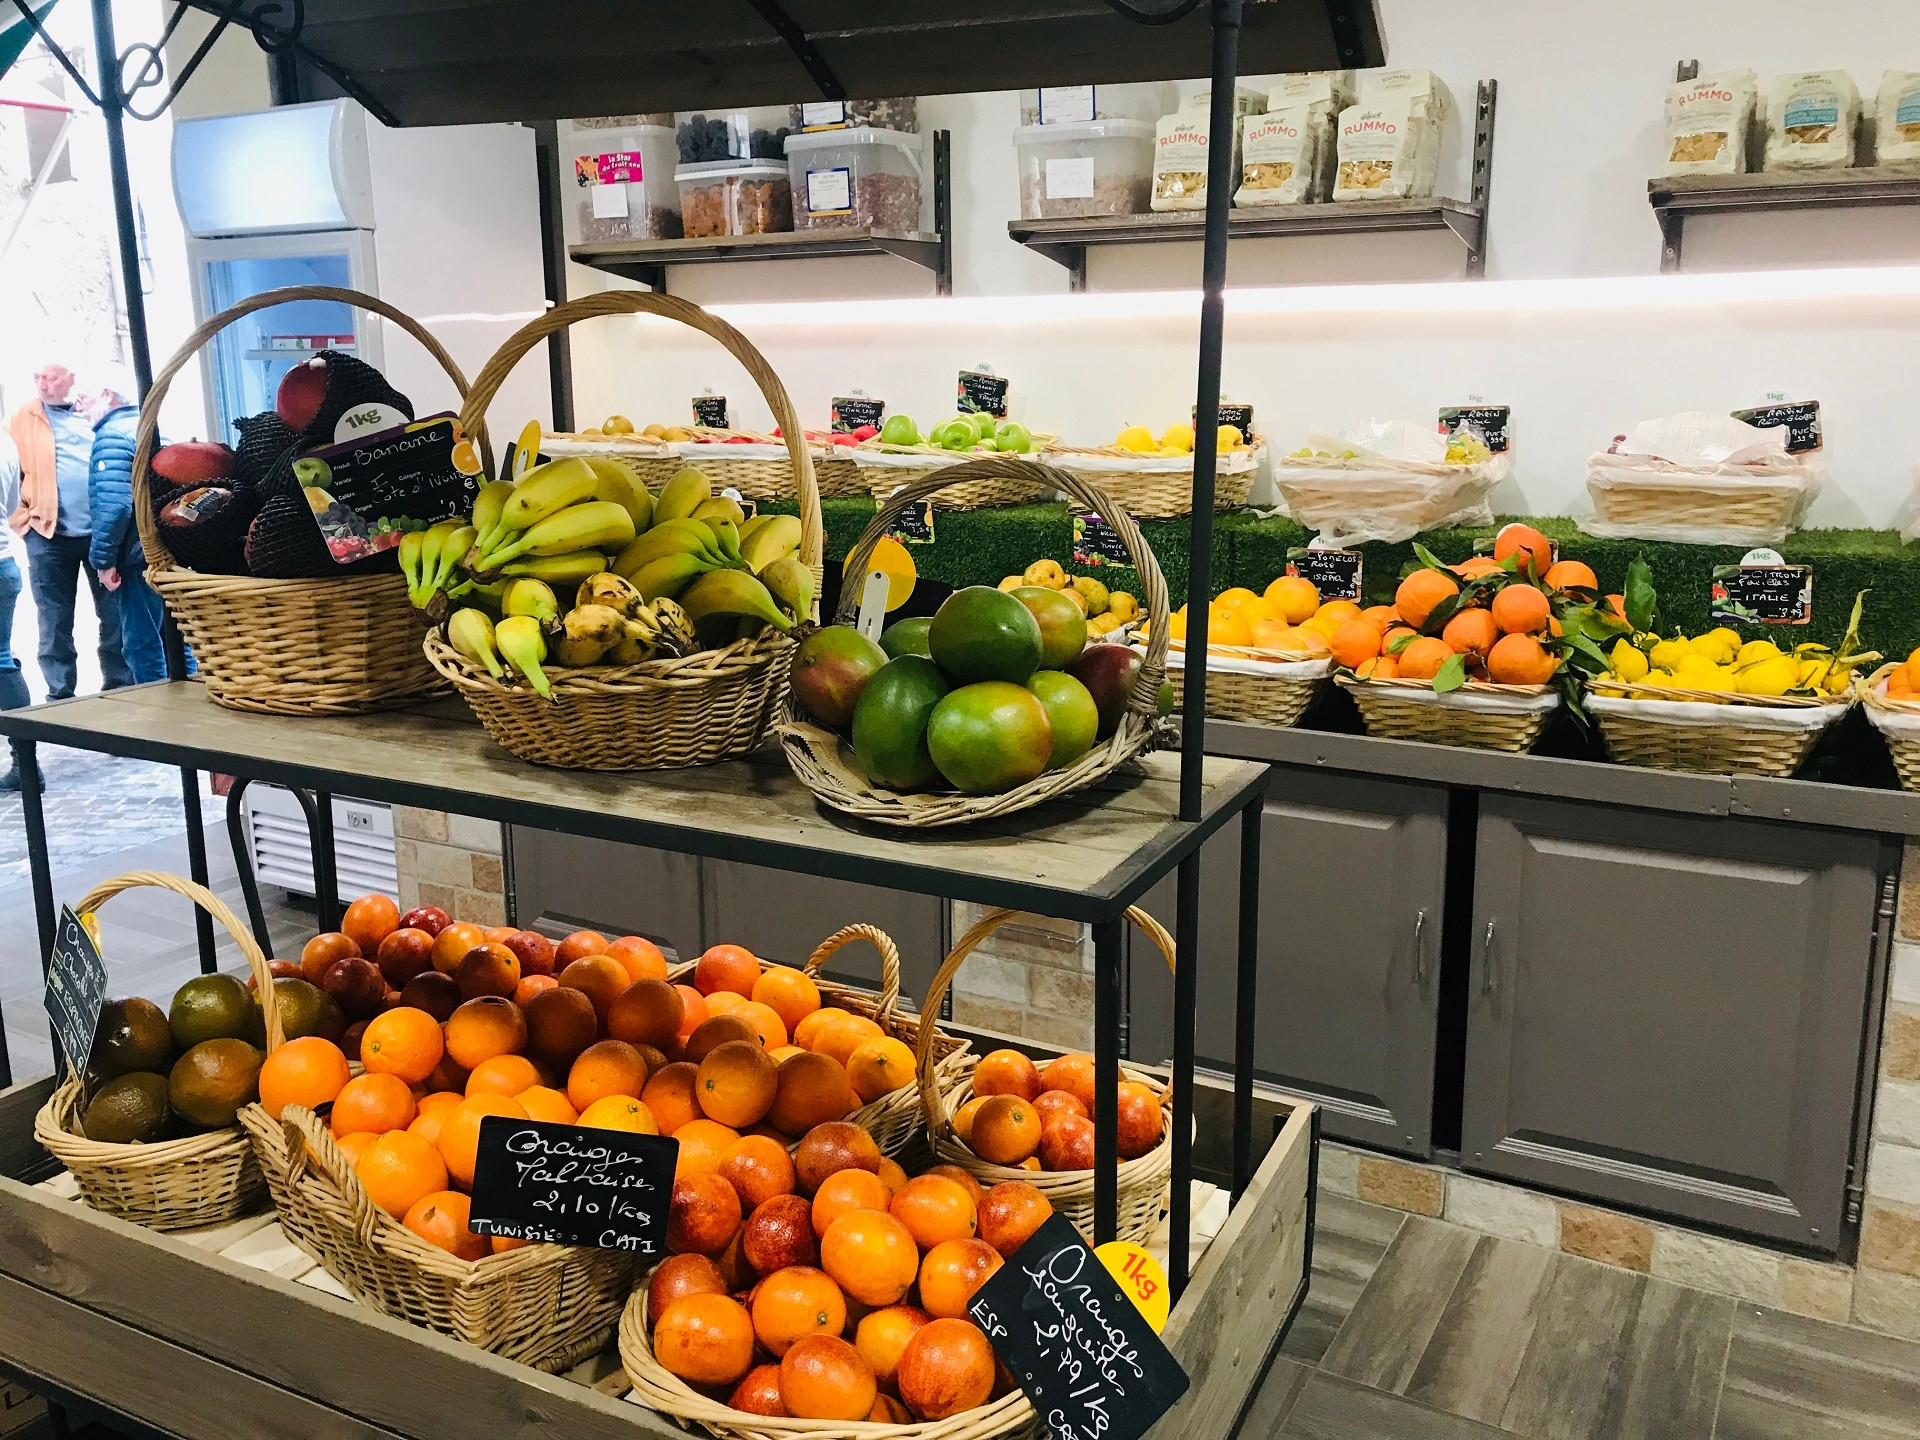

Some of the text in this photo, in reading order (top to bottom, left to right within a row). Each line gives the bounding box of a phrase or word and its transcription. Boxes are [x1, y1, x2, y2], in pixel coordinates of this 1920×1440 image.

[1679, 90, 1733, 106] RUMMO
[1249, 125, 1298, 142] RUMMO
[1343, 121, 1397, 137] RUMMO
[1159, 132, 1208, 148] RUMMO
[345, 408, 382, 429] 1kg
[353, 429, 444, 466] Banane
[1750, 552, 1771, 560] 1kg
[1745, 593, 1789, 602] ITALIE
[505, 1129, 644, 1171] Oranges
[1121, 1251, 1159, 1301] 1kg
[969, 1298, 1009, 1338] ESP
[1048, 1244, 1144, 1379] Oranges
